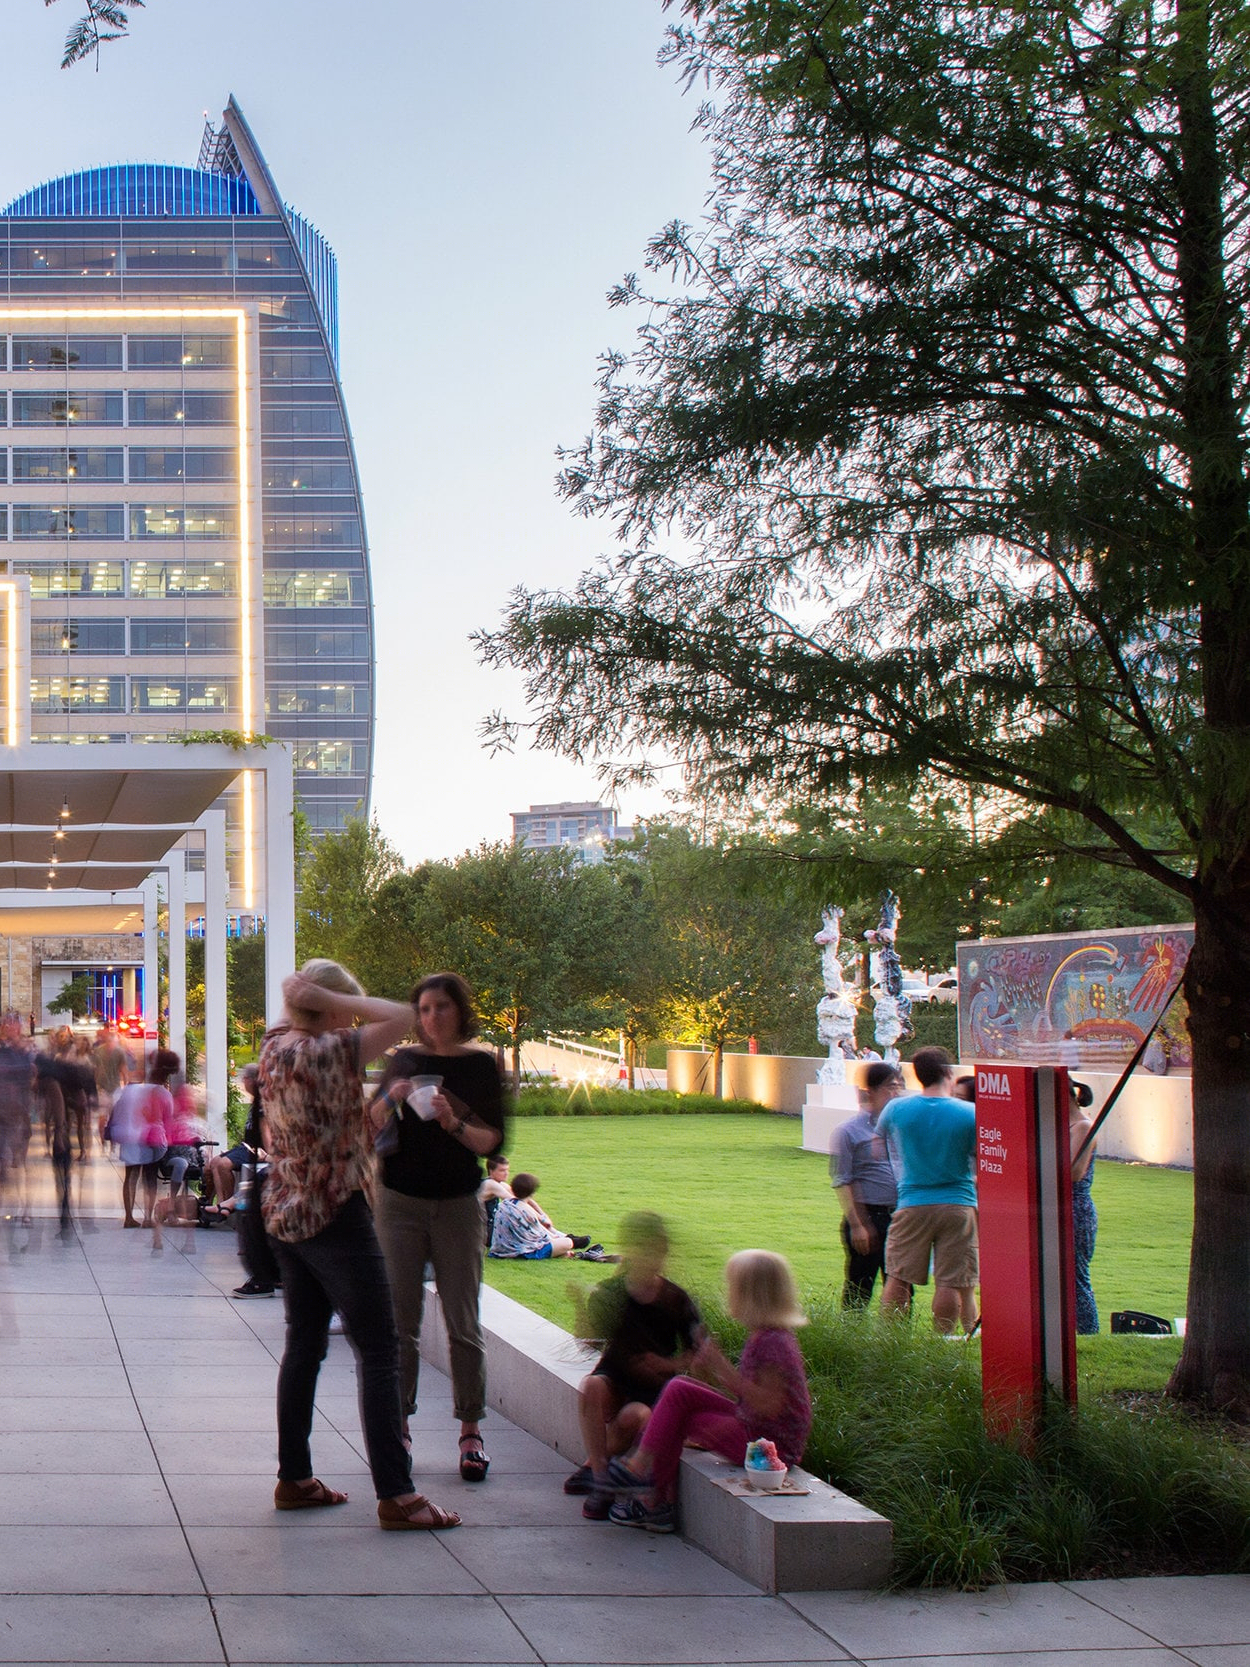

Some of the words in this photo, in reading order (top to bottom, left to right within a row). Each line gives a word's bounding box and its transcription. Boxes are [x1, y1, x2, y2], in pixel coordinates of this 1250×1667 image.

[978, 1071, 1011, 1095] DMA
[979, 1126, 1002, 1143] Eagle
[979, 1142, 1008, 1161] Family
[980, 1159, 1004, 1174] Plaza
